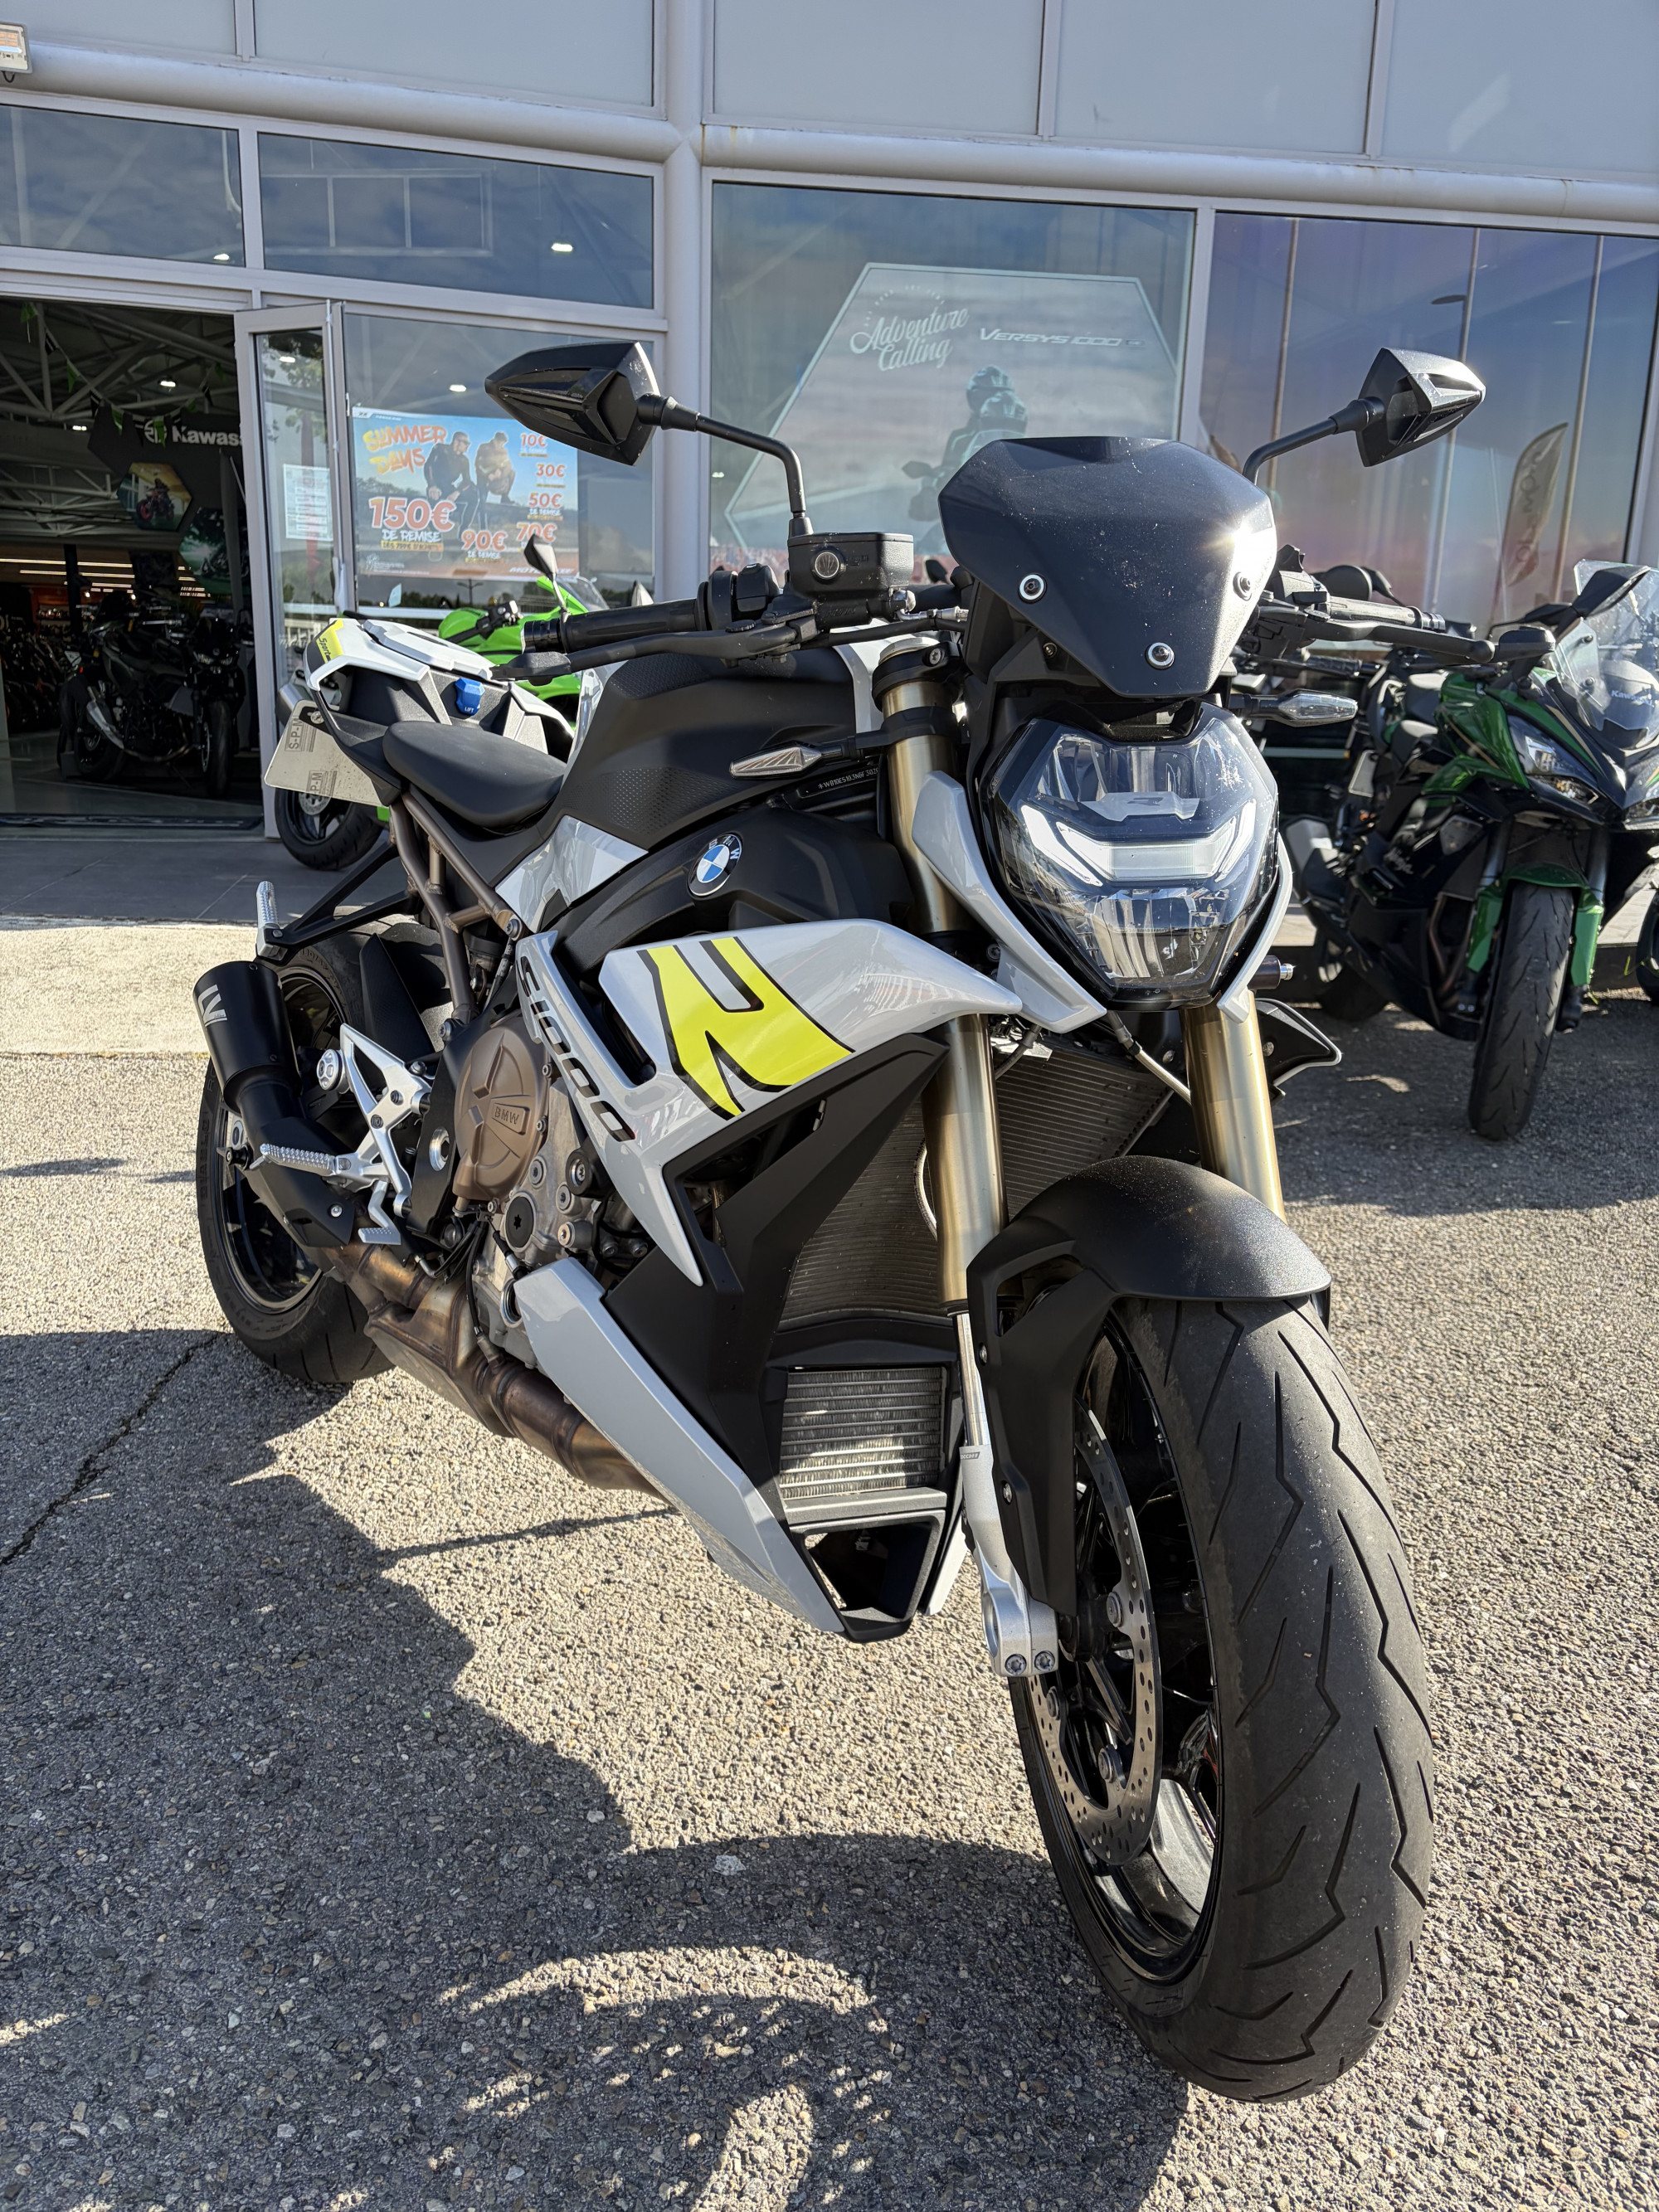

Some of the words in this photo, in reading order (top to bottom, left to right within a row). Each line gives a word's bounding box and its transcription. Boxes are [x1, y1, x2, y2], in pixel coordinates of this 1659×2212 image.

[849, 306, 970, 354] Adventure
[1070, 336, 1122, 347] 1000
[878, 338, 953, 372] Calling
[172, 425, 242, 447] Kawas
[362, 424, 447, 452] SUMMER
[520, 433, 547, 448] 10€
[369, 447, 426, 474] DAYS
[535, 463, 567, 479] 30€
[528, 492, 562, 508] 50€
[368, 496, 457, 532] 150€
[382, 529, 398, 542] DE
[399, 530, 442, 543] REMISE
[460, 528, 508, 552] 90€
[515, 522, 557, 542] 70€
[319, 637, 332, 656] Sport
[708, 834, 741, 860] BMW
[494, 1106, 520, 1125] BMW
